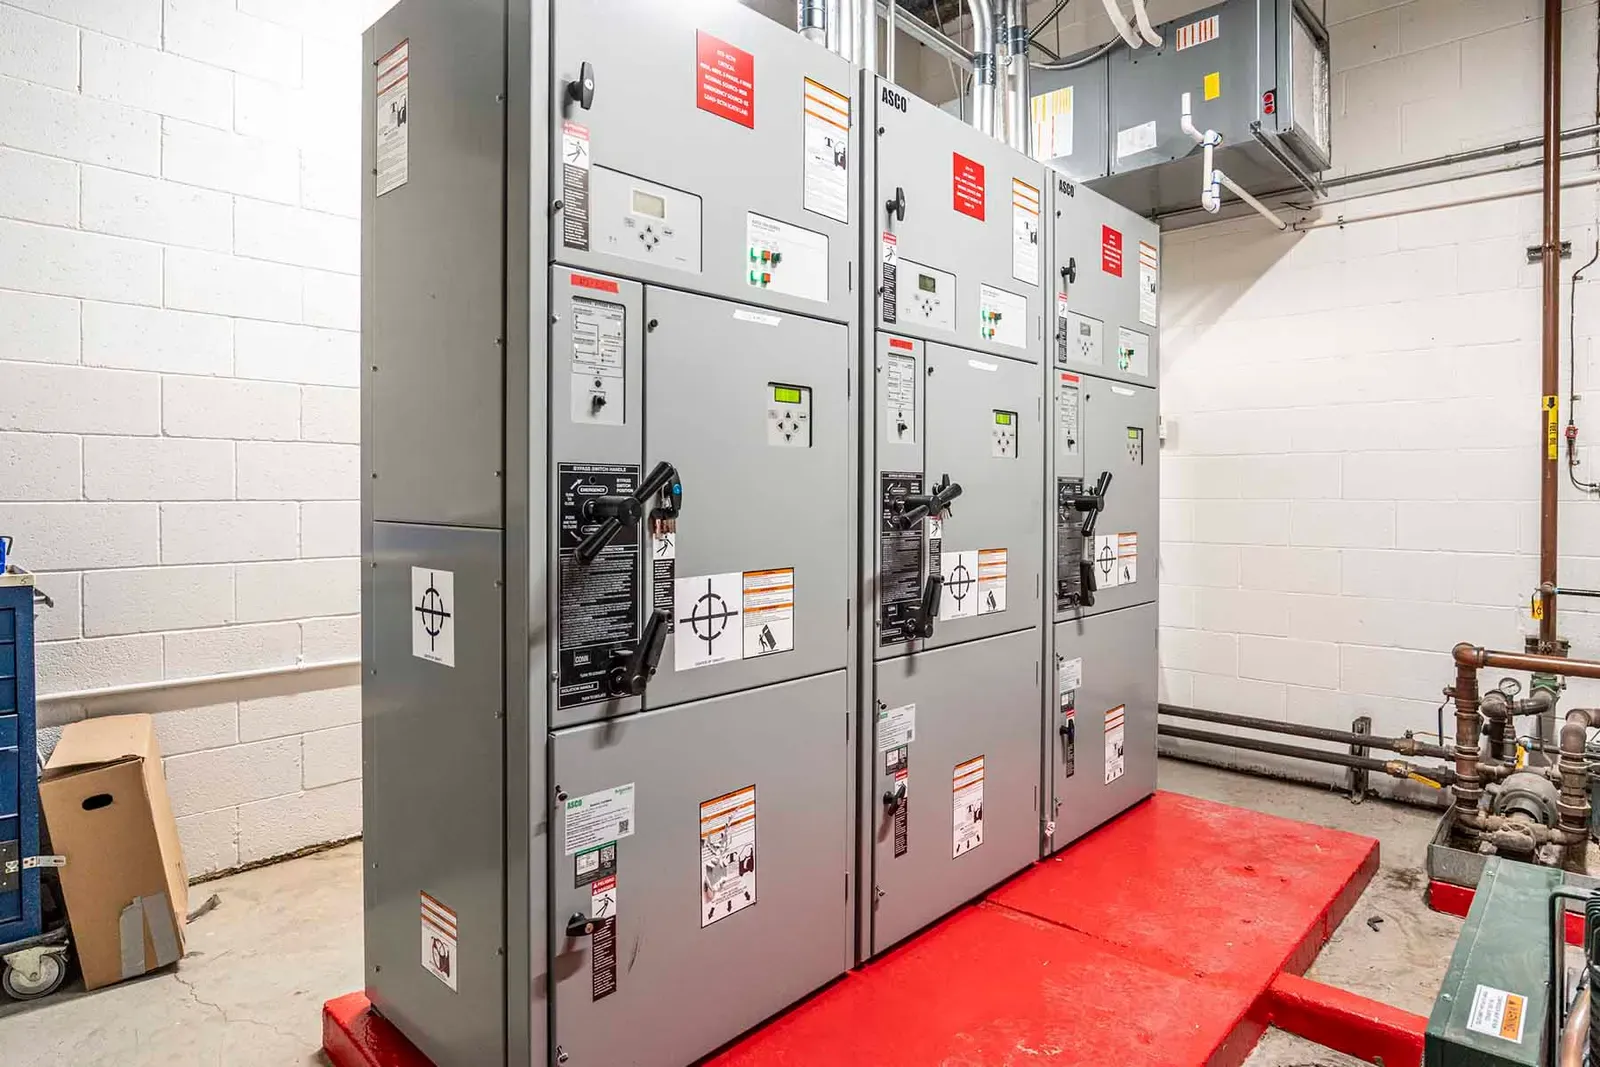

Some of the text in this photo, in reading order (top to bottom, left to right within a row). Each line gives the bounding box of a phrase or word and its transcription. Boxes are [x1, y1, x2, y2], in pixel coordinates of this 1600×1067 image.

[882, 86, 906, 114] ASCO
[1058, 179, 1074, 198] ASCO
[575, 655, 589, 663] CONN
[567, 799, 582, 809] ASCO
